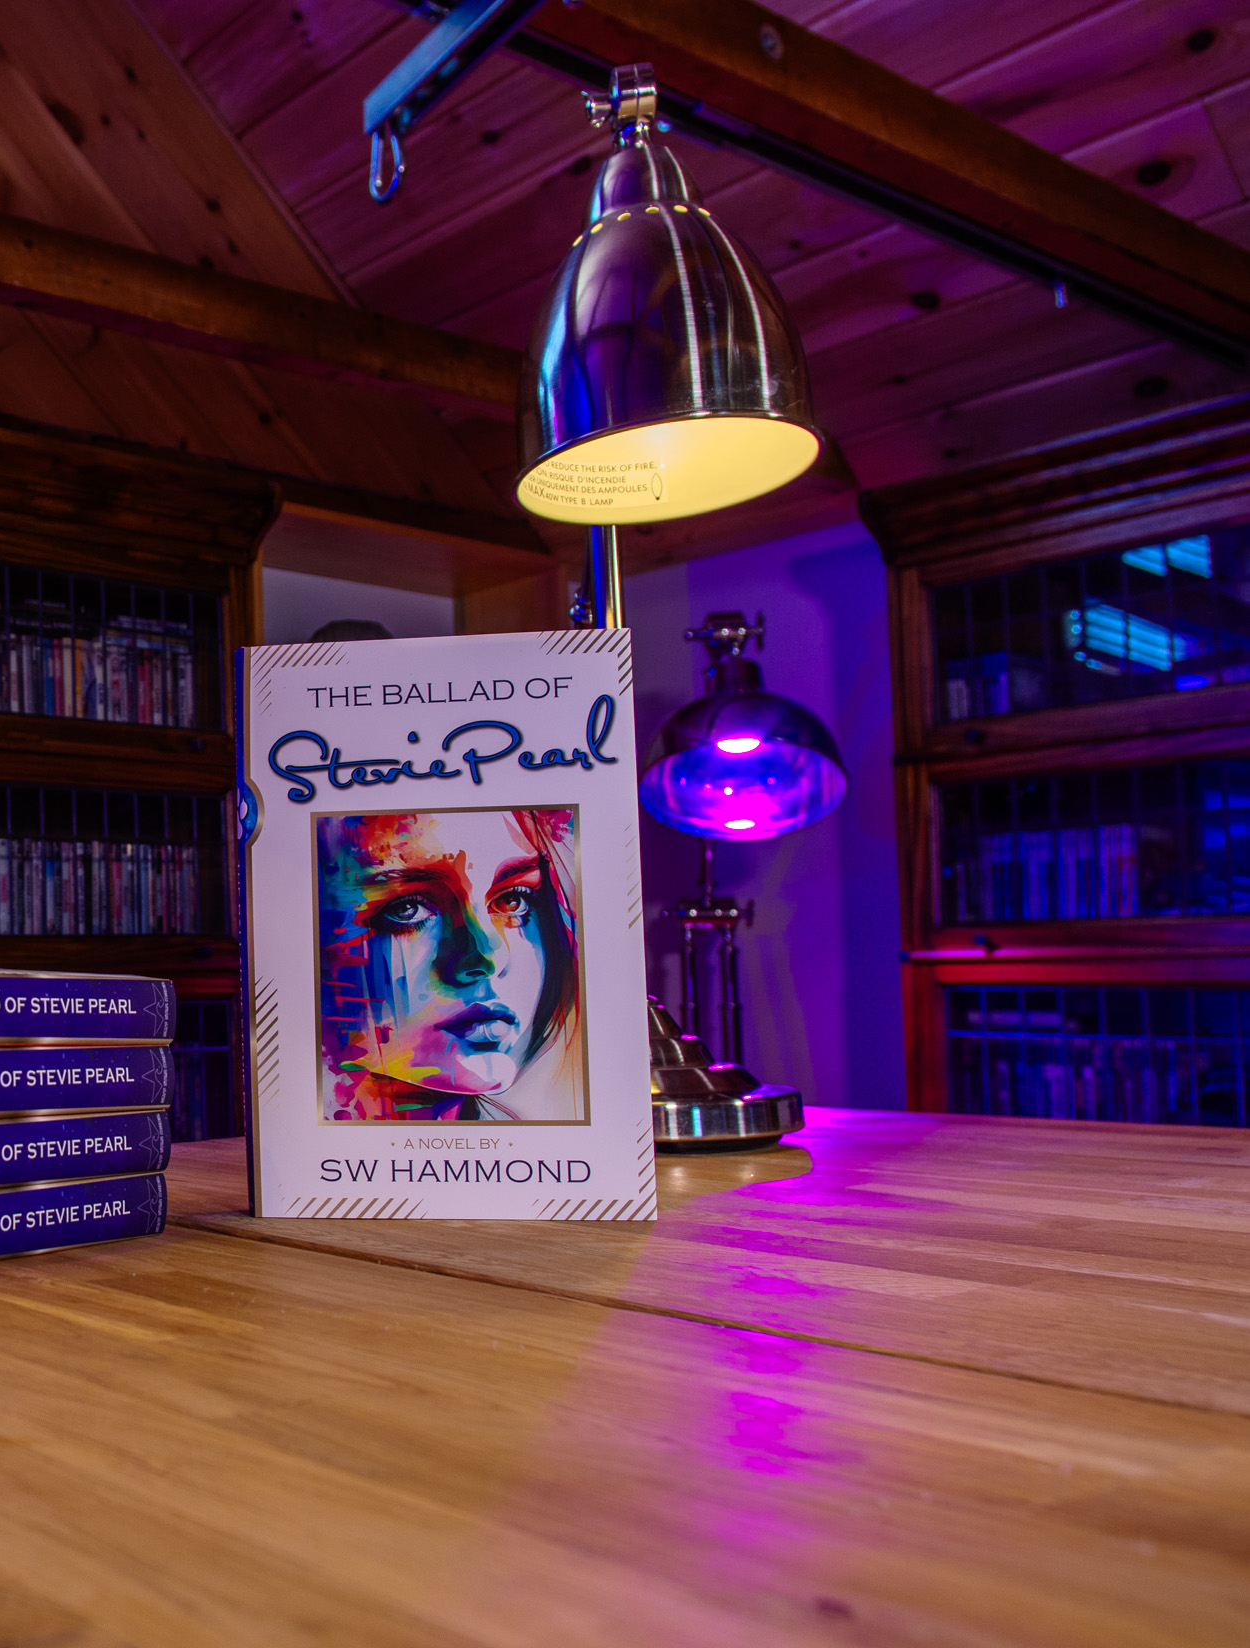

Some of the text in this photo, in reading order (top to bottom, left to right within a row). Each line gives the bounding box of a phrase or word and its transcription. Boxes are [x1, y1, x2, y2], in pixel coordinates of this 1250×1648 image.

[549, 471, 575, 483] RISQUE
[551, 461, 579, 473] REDUCE
[580, 464, 597, 473] THE
[598, 464, 618, 473] RISK
[619, 463, 633, 473] OF
[527, 483, 546, 498] MAX
[560, 495, 578, 505] TYPE
[590, 498, 613, 506] LAMP
[536, 477, 580, 493] UNIQUEMENT
[581, 485, 597, 494] DES
[598, 484, 648, 494] AMPOULES
[307, 676, 573, 708] THE BALLAD OF
[268, 694, 617, 802] Stevie Pearl
[4, 997, 27, 1013] OF
[31, 997, 85, 1014] STEVIE
[88, 998, 137, 1014] PEARL
[0, 1070, 22, 1088] OF
[26, 1068, 82, 1087] STEVIE
[85, 1066, 135, 1084] PEARL
[1, 1143, 24, 1162] OF
[27, 1139, 81, 1160] STEVIE
[84, 1135, 132, 1155] PEARL
[403, 1137, 501, 1150] A NOVEL BY
[319, 1158, 592, 1184] SW HAMMOND
[0, 1213, 22, 1232] OF
[25, 1205, 80, 1228] STEVIE
[83, 1200, 131, 1221] PEARL
